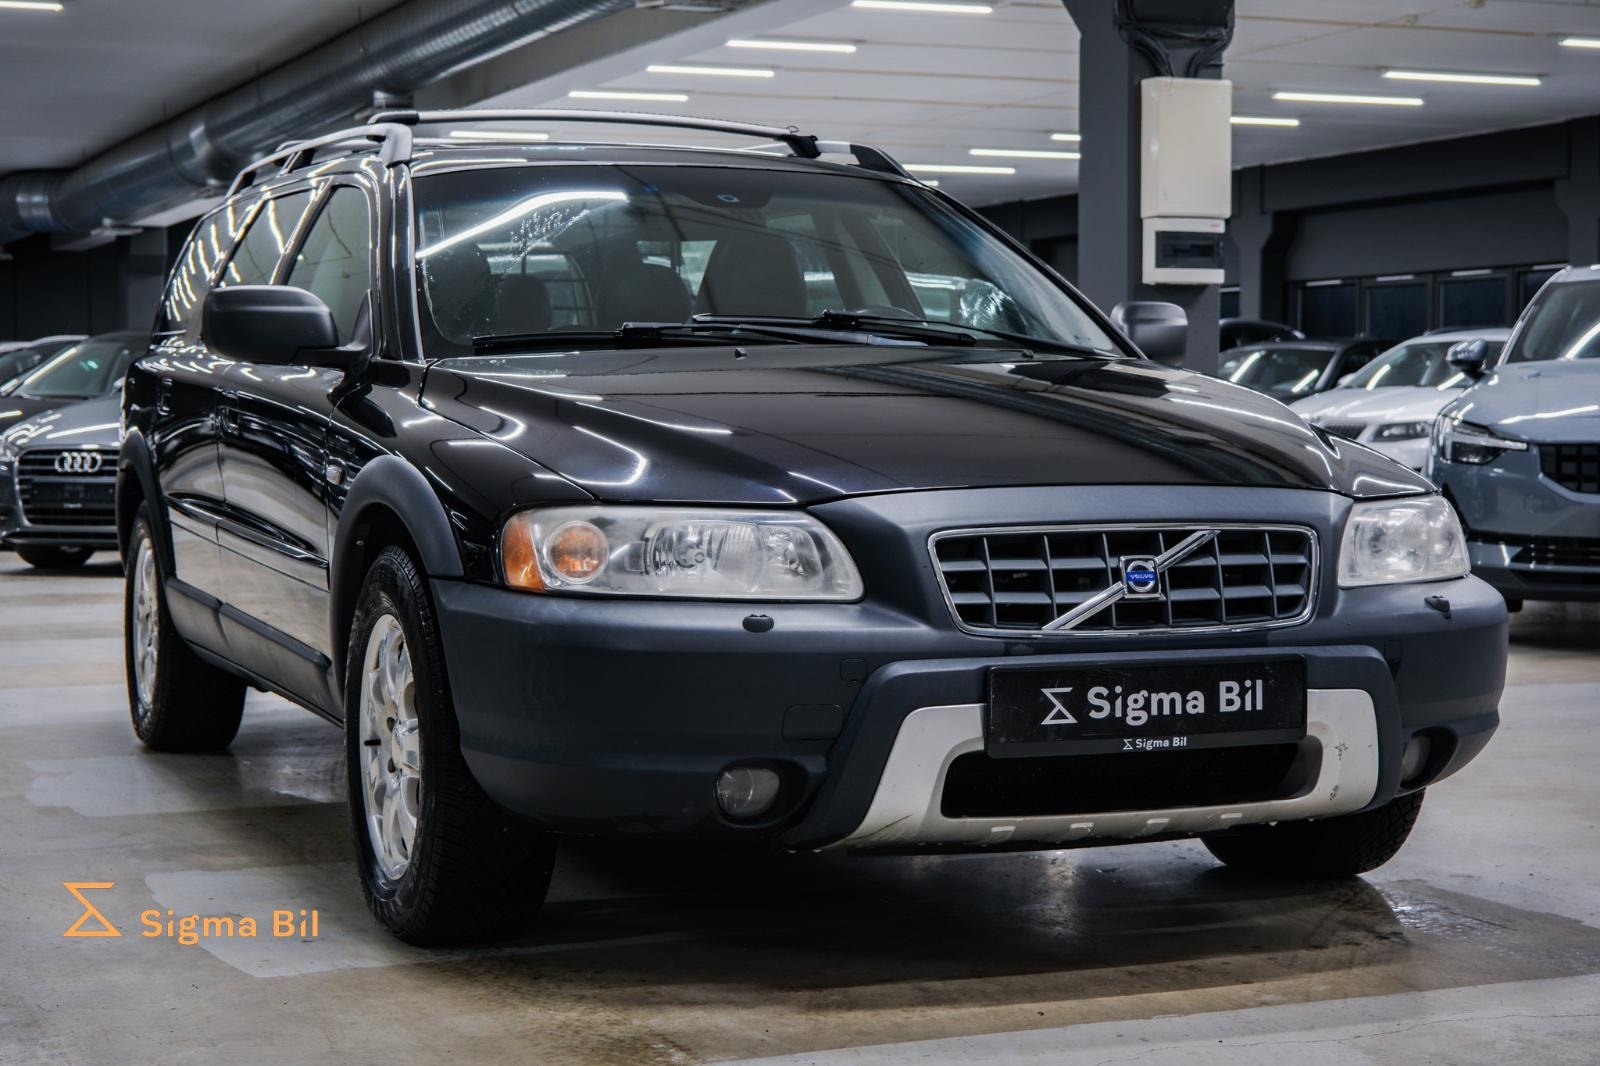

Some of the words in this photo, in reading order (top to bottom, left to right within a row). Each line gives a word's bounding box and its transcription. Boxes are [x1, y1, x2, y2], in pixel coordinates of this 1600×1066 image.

[1086, 685, 1205, 726] Sigma
[1218, 679, 1263, 713] Bil
[1135, 738, 1169, 749] Sigma
[1172, 736, 1187, 747] Bil
